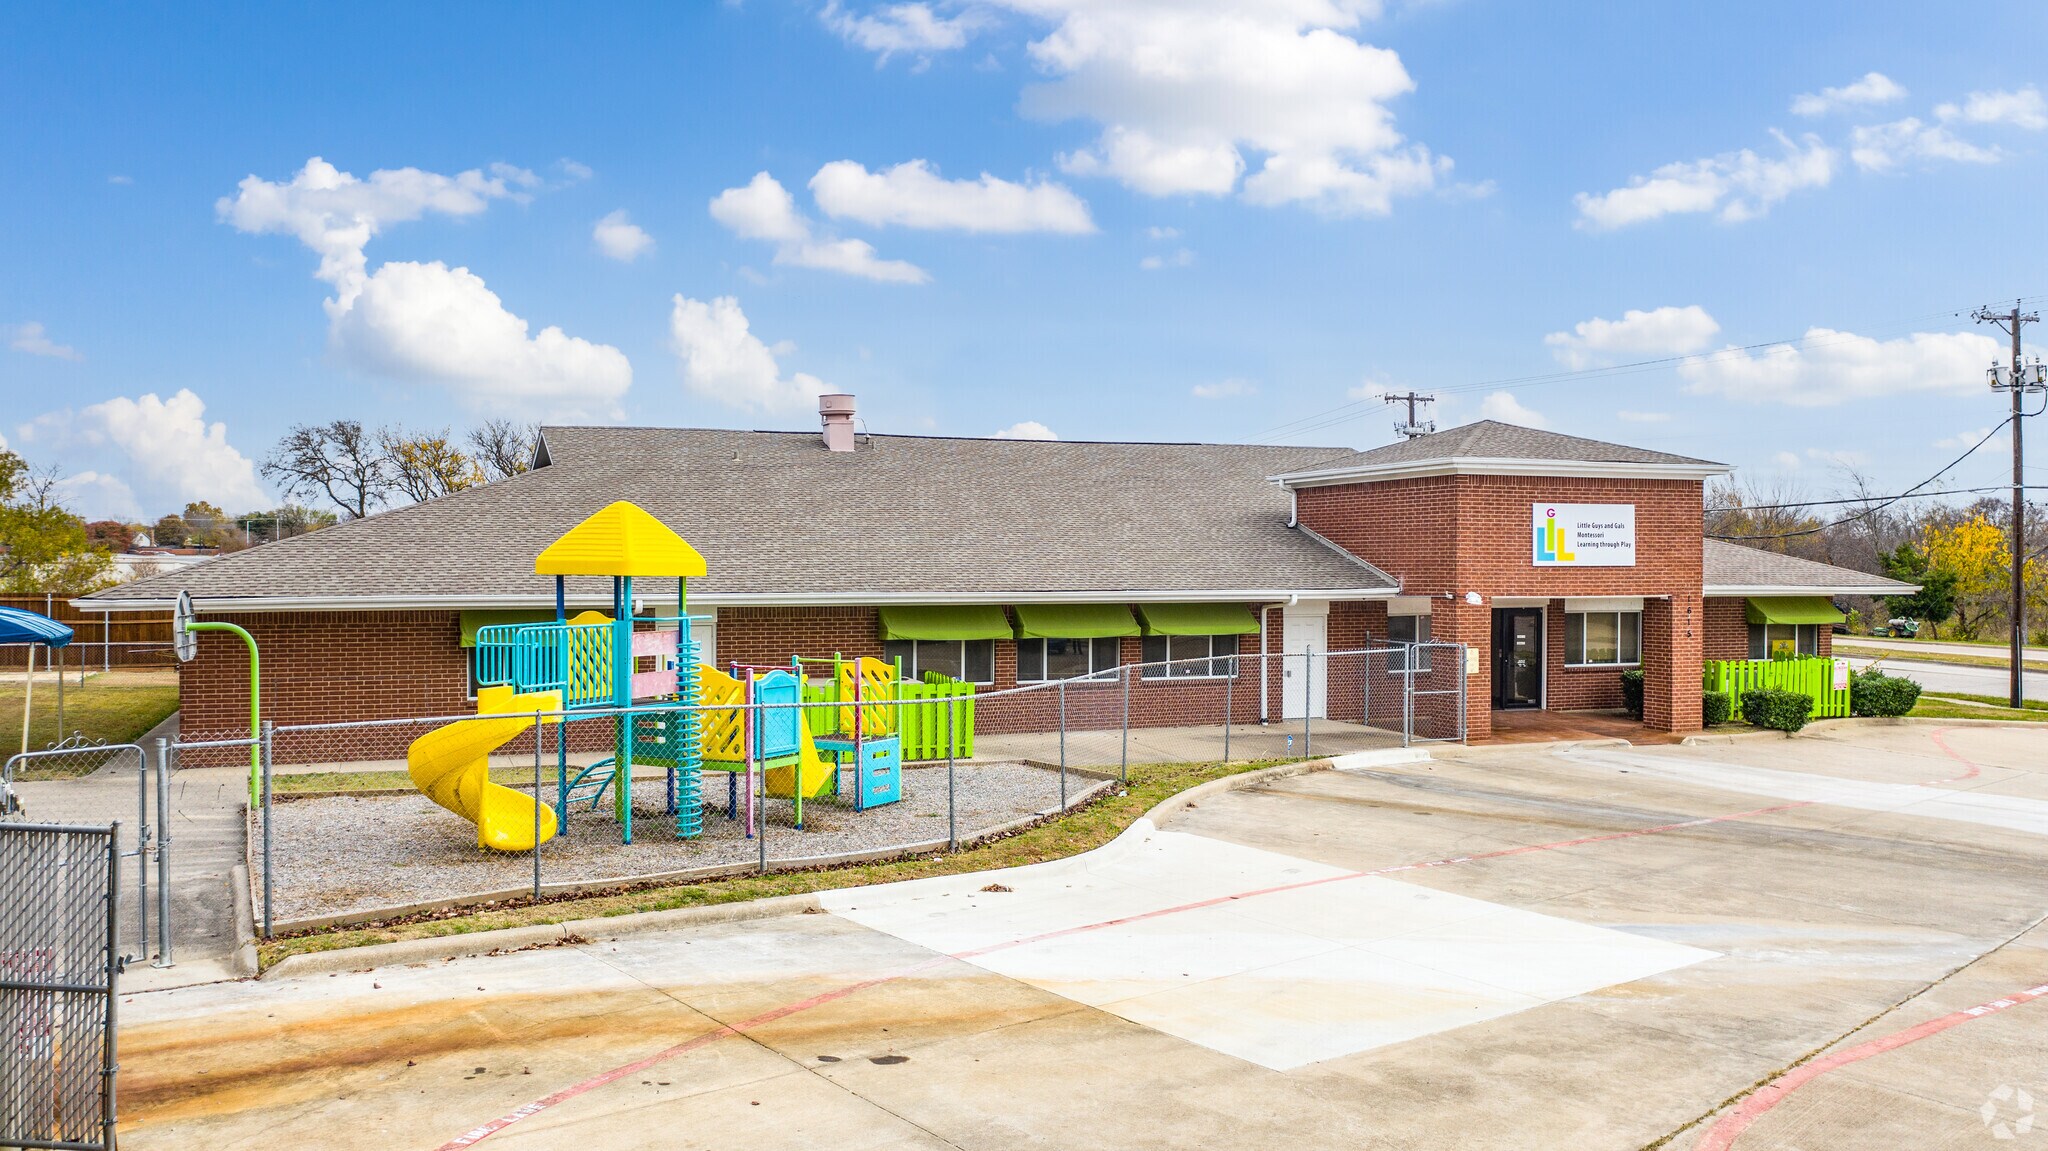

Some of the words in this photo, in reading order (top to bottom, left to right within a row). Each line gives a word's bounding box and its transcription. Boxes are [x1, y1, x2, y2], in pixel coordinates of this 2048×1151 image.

[1546, 508, 1556, 518] G
[1592, 522, 1603, 530] Guys
[1577, 541, 1599, 549] Learning
[1600, 541, 1620, 549] through
[1621, 541, 1631, 549] Play
